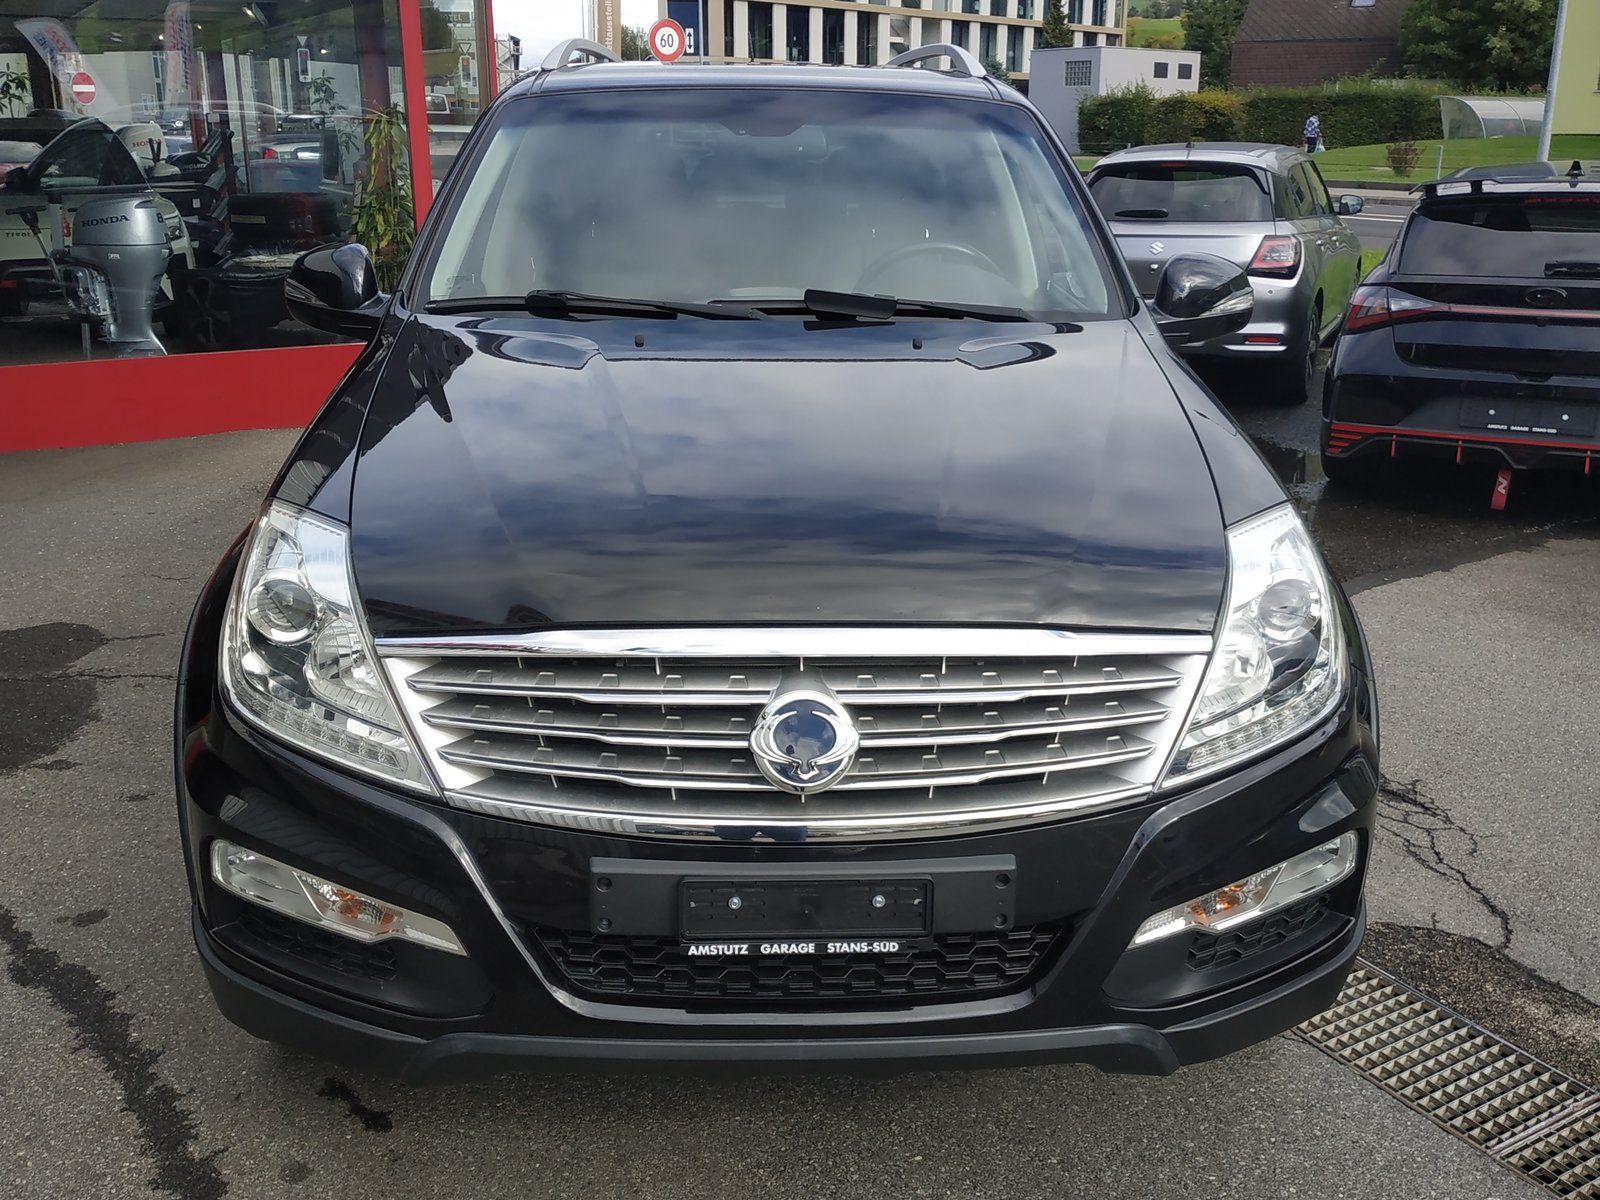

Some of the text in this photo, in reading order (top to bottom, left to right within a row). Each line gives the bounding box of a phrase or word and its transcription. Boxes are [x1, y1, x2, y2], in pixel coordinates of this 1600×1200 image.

[660, 33, 674, 48] 60
[81, 214, 130, 228] HONDA
[687, 941, 899, 956] AMSTUTZ GARAGE STANS-SÜD
